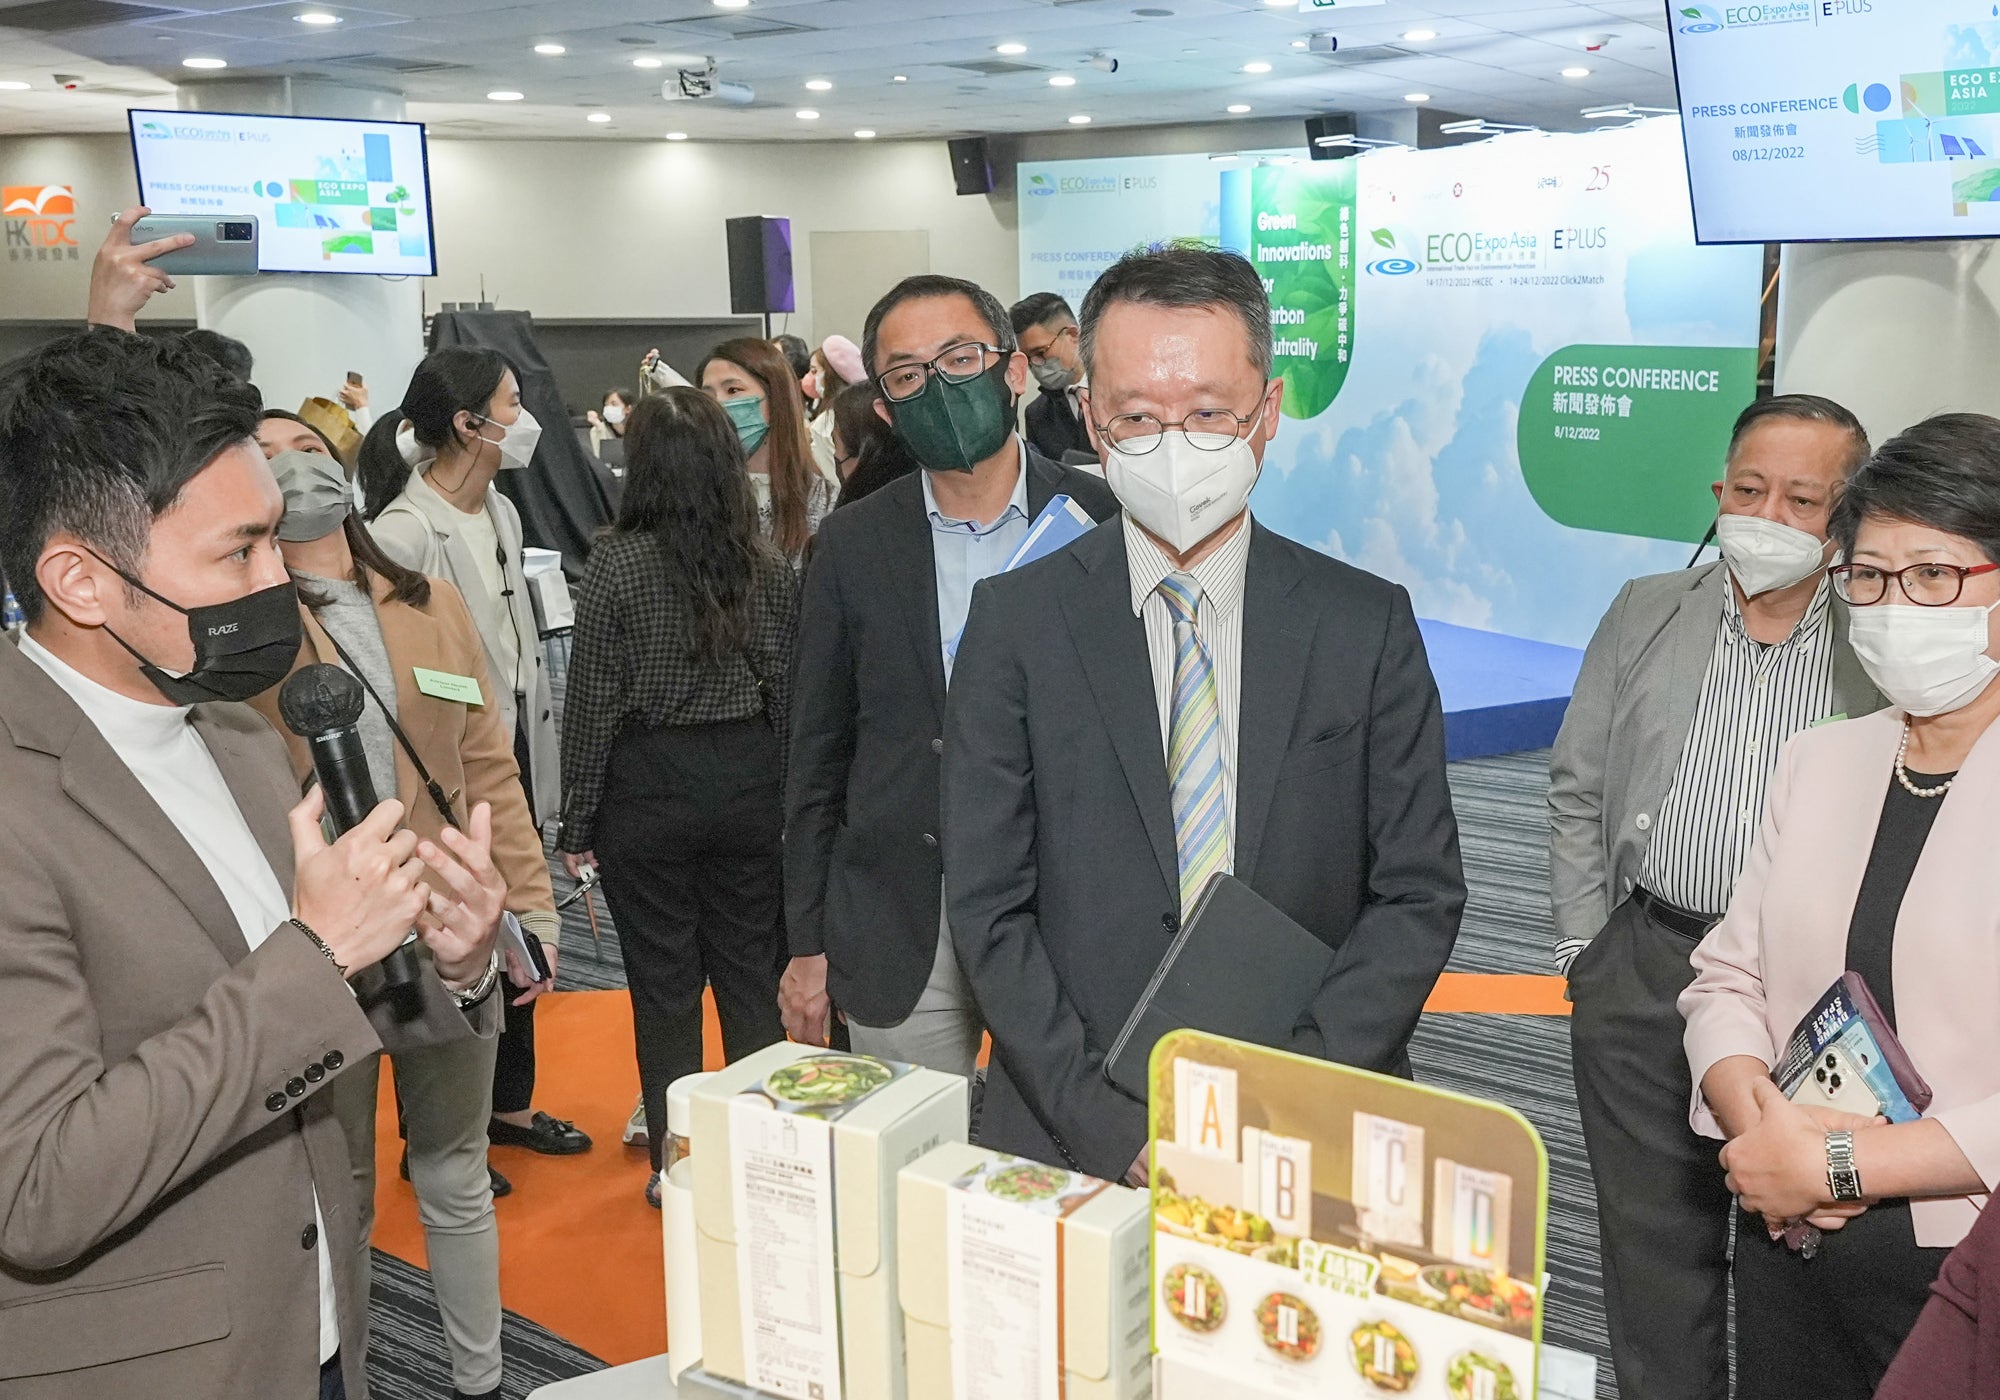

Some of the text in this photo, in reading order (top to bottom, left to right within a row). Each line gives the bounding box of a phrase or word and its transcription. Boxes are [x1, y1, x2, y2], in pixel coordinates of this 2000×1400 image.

[1726, 6, 1762, 24] ECO
[1762, 5, 1788, 15] Expo
[1789, 2, 1809, 12] Asia
[1950, 73, 1982, 86] ECO
[1951, 87, 1988, 99] ASIA
[1692, 97, 1838, 118] PRESS CONFERENCE
[1734, 123, 1797, 139] 新聞發佈會
[1732, 146, 1804, 161] 08/12/2022
[149, 182, 250, 194] PRESS CONFERENCE
[318, 181, 338, 190] ECO
[1060, 177, 1085, 190] ECO
[1585, 165, 1611, 191] 25
[1257, 211, 1297, 232] Green
[5, 219, 78, 246] HKTDC
[1031, 252, 1061, 262] PRESS
[1257, 241, 1332, 262] Innovations
[1427, 233, 1473, 262] ECO
[1475, 233, 1508, 253] Expo
[1509, 231, 1537, 249] Asia
[1260, 274, 1274, 293] or
[1560, 275, 1605, 285] Click2Match
[1270, 305, 1305, 325] arbon
[1273, 337, 1318, 361] utrality
[1554, 365, 1719, 392] PRESS CONFERENCE
[1553, 391, 1633, 418] 新聞發佈會
[1554, 426, 1600, 440] 8/12/2022
[208, 622, 239, 636] RAZE
[1811, 996, 1842, 1031] SPACE
[1817, 1011, 1849, 1046] DIVING
[1201, 1083, 1222, 1149] A
[1387, 1138, 1406, 1207] C
[1277, 1156, 1295, 1220] B
